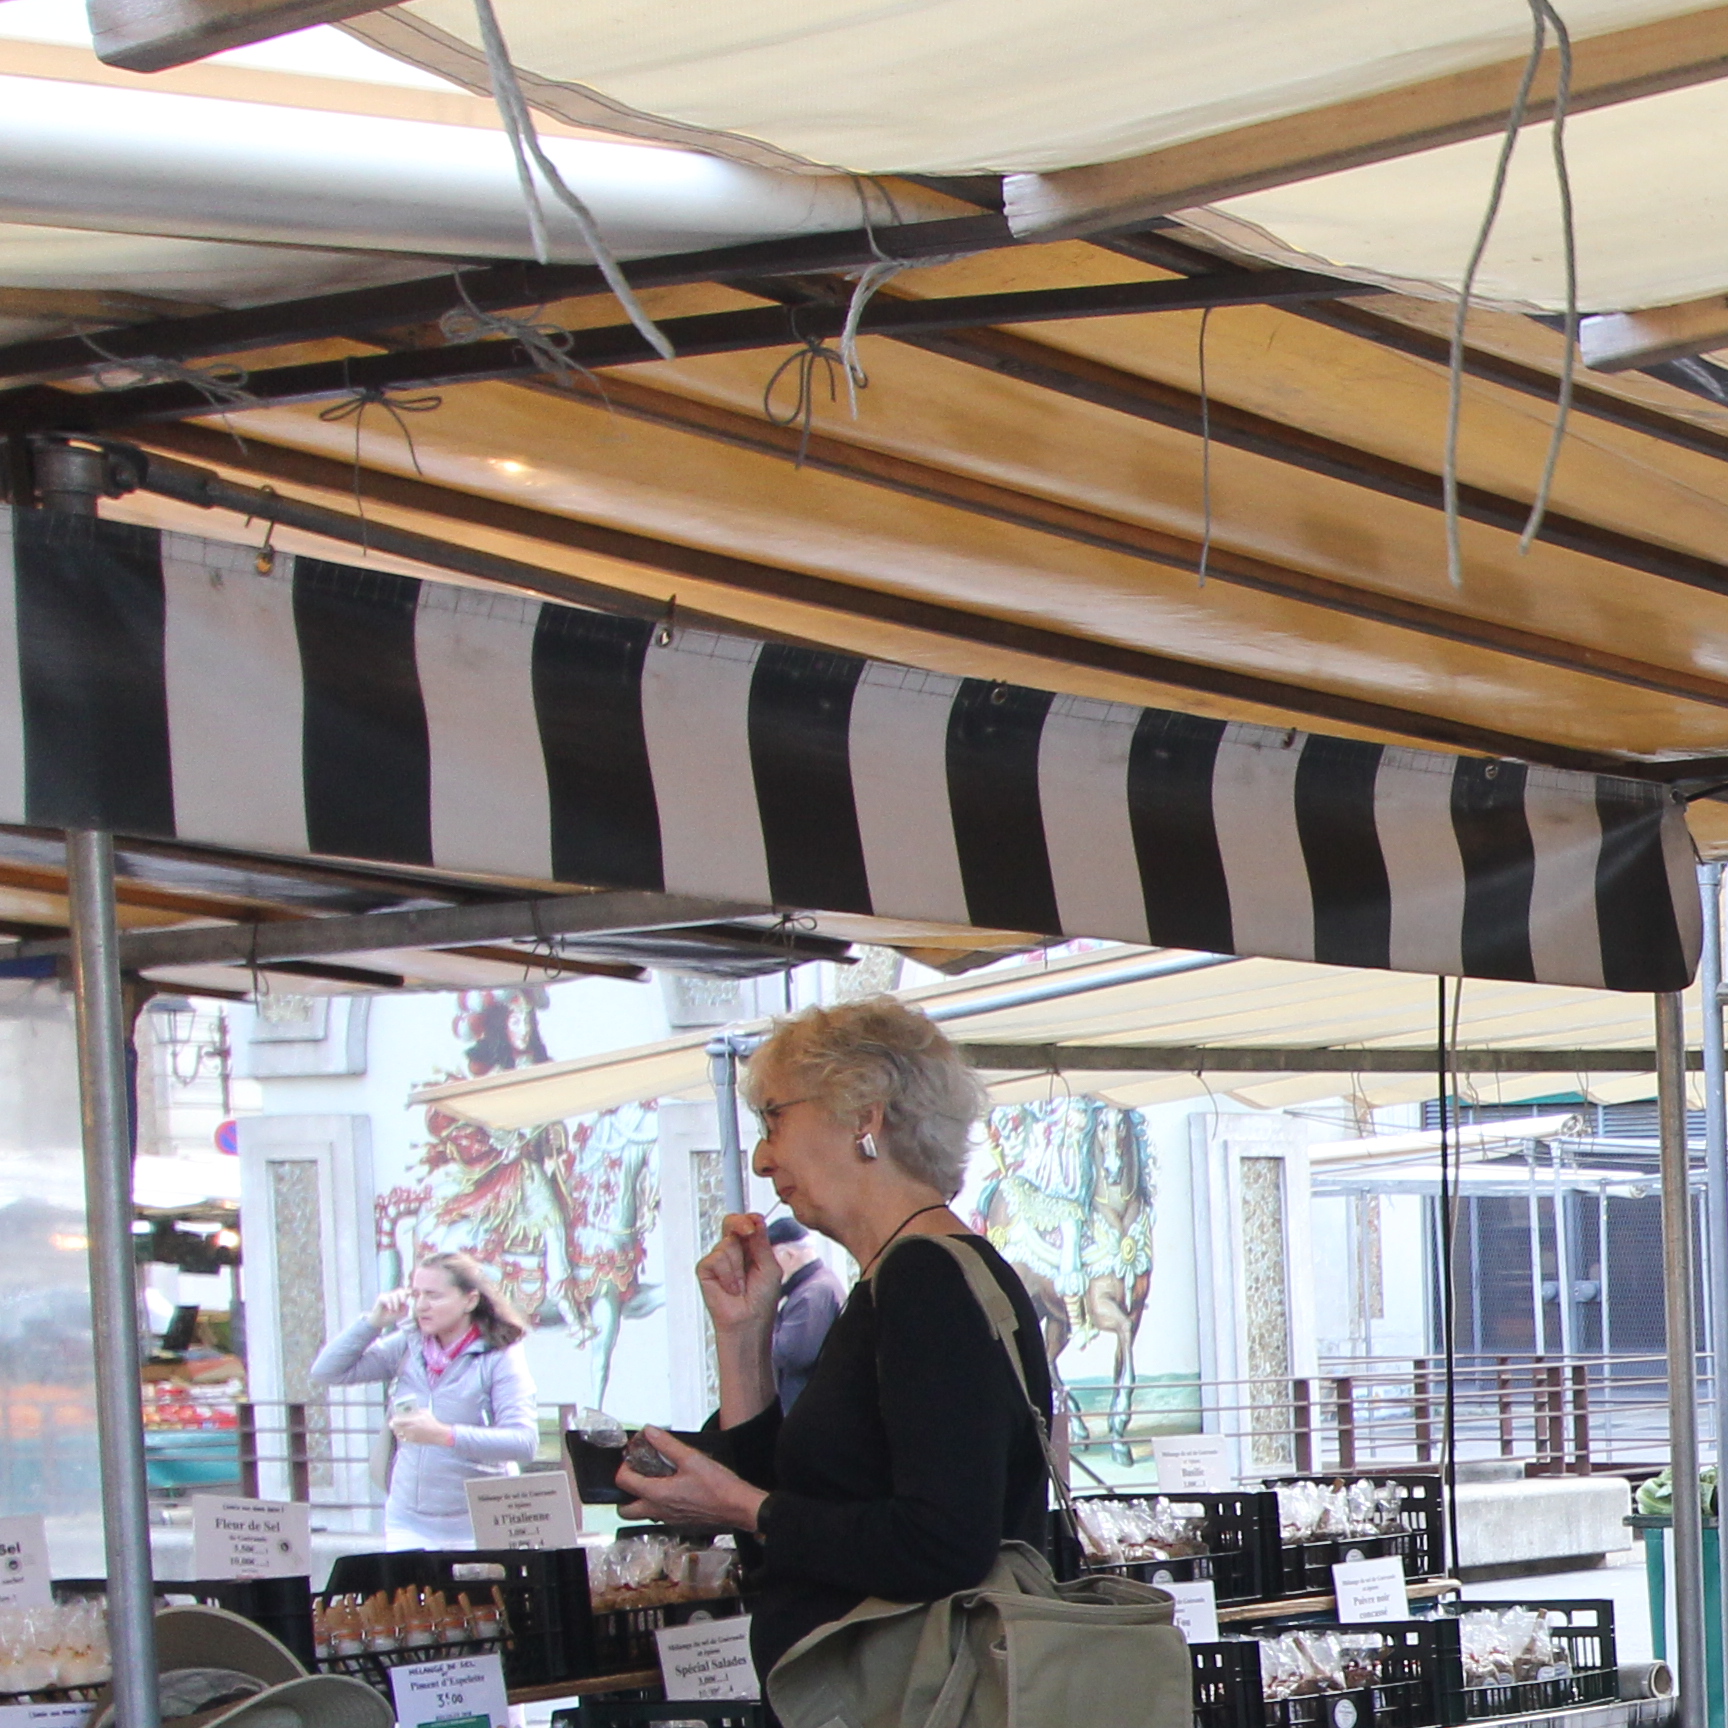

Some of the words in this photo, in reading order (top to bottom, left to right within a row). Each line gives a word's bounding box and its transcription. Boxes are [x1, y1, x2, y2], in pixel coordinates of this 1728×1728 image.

[215, 1518, 244, 1530] Fleur
[248, 1520, 259, 1531] de
[264, 1521, 280, 1532] Sel
[675, 1661, 710, 1678] Spécial
[711, 1655, 747, 1669] Salades
